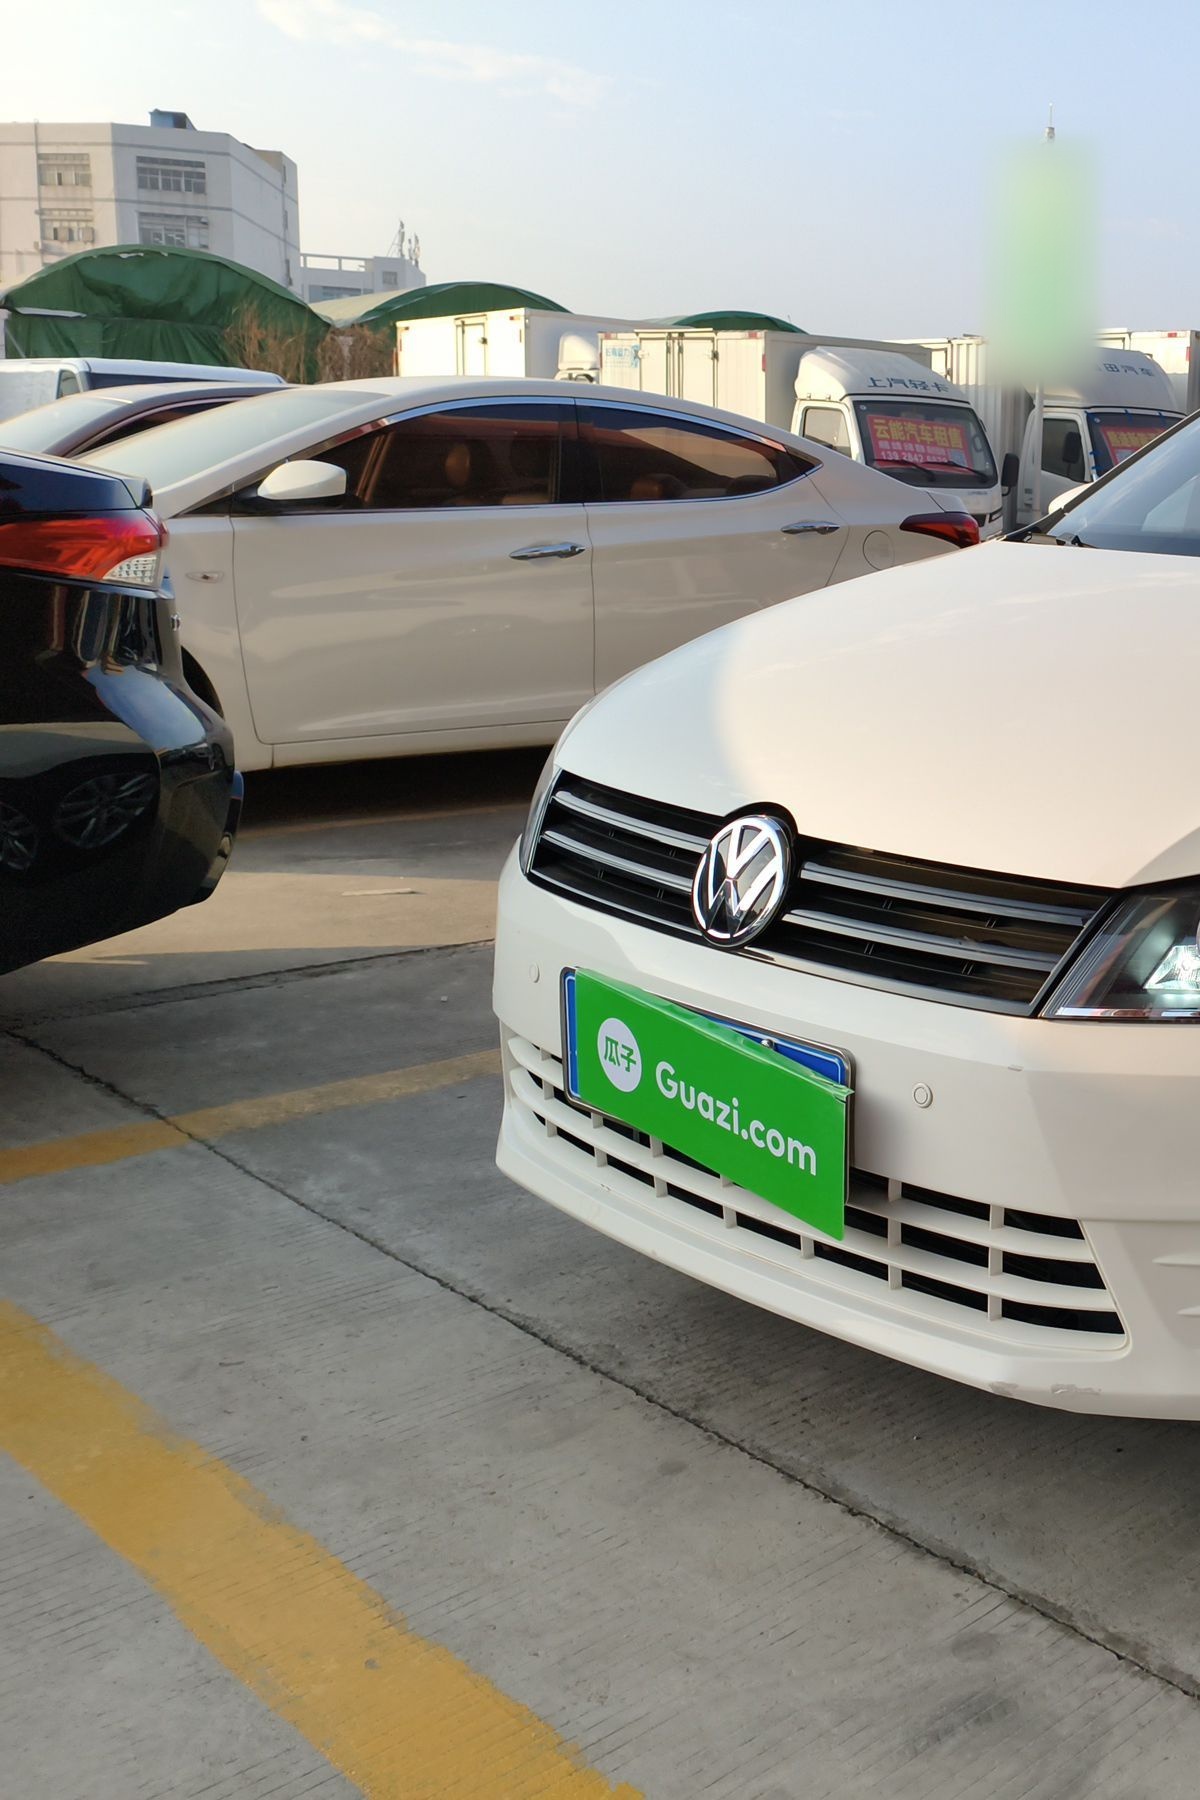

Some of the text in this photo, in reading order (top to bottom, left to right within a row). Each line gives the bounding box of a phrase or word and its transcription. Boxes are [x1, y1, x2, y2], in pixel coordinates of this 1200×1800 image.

[1097, 362, 1155, 377] 田汽车
[868, 377, 949, 393] 上汽轻卡
[602, 1034, 637, 1074] 瓜子
[655, 1061, 817, 1176] Guazi.com
